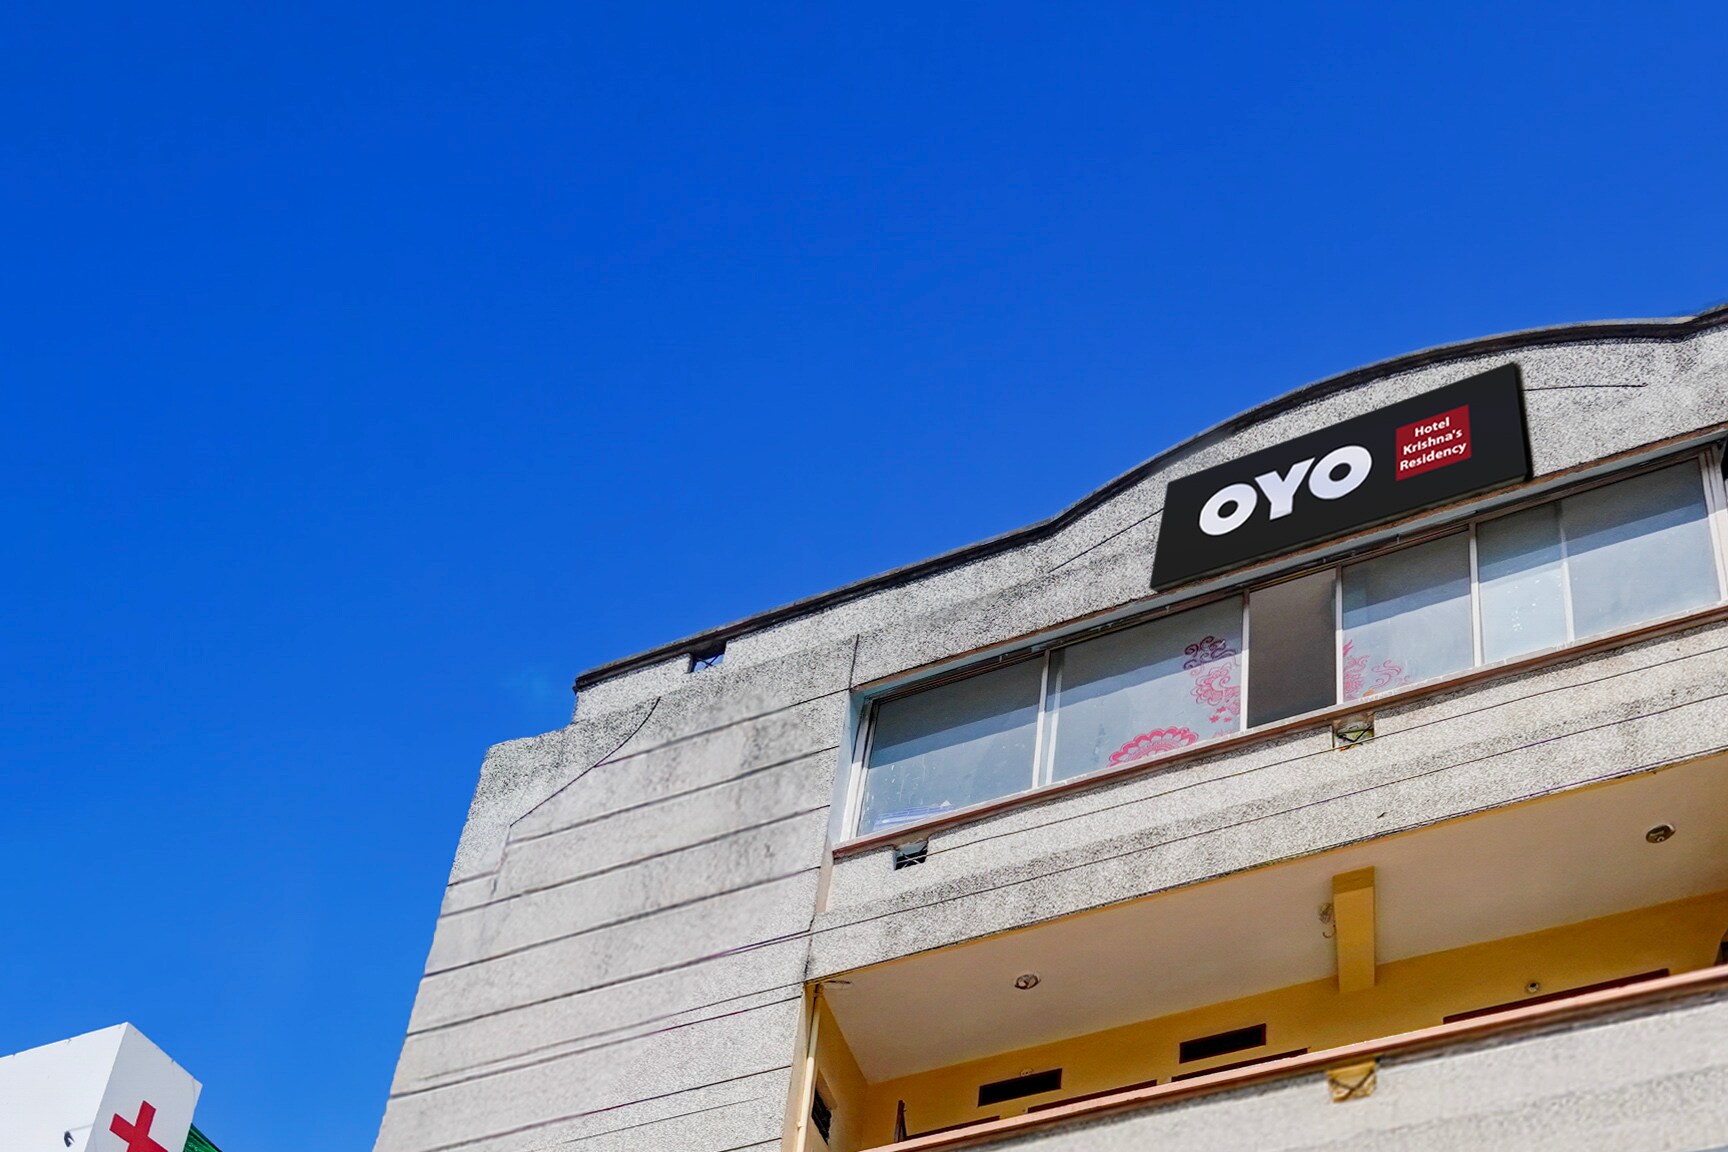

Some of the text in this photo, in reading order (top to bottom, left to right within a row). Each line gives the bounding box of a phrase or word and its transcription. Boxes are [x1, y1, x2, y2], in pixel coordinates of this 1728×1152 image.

[1403, 428, 1463, 455] Krishna's
[1415, 417, 1450, 438] Hotel
[1400, 442, 1467, 471] Residency
[1198, 444, 1373, 536] OYO
